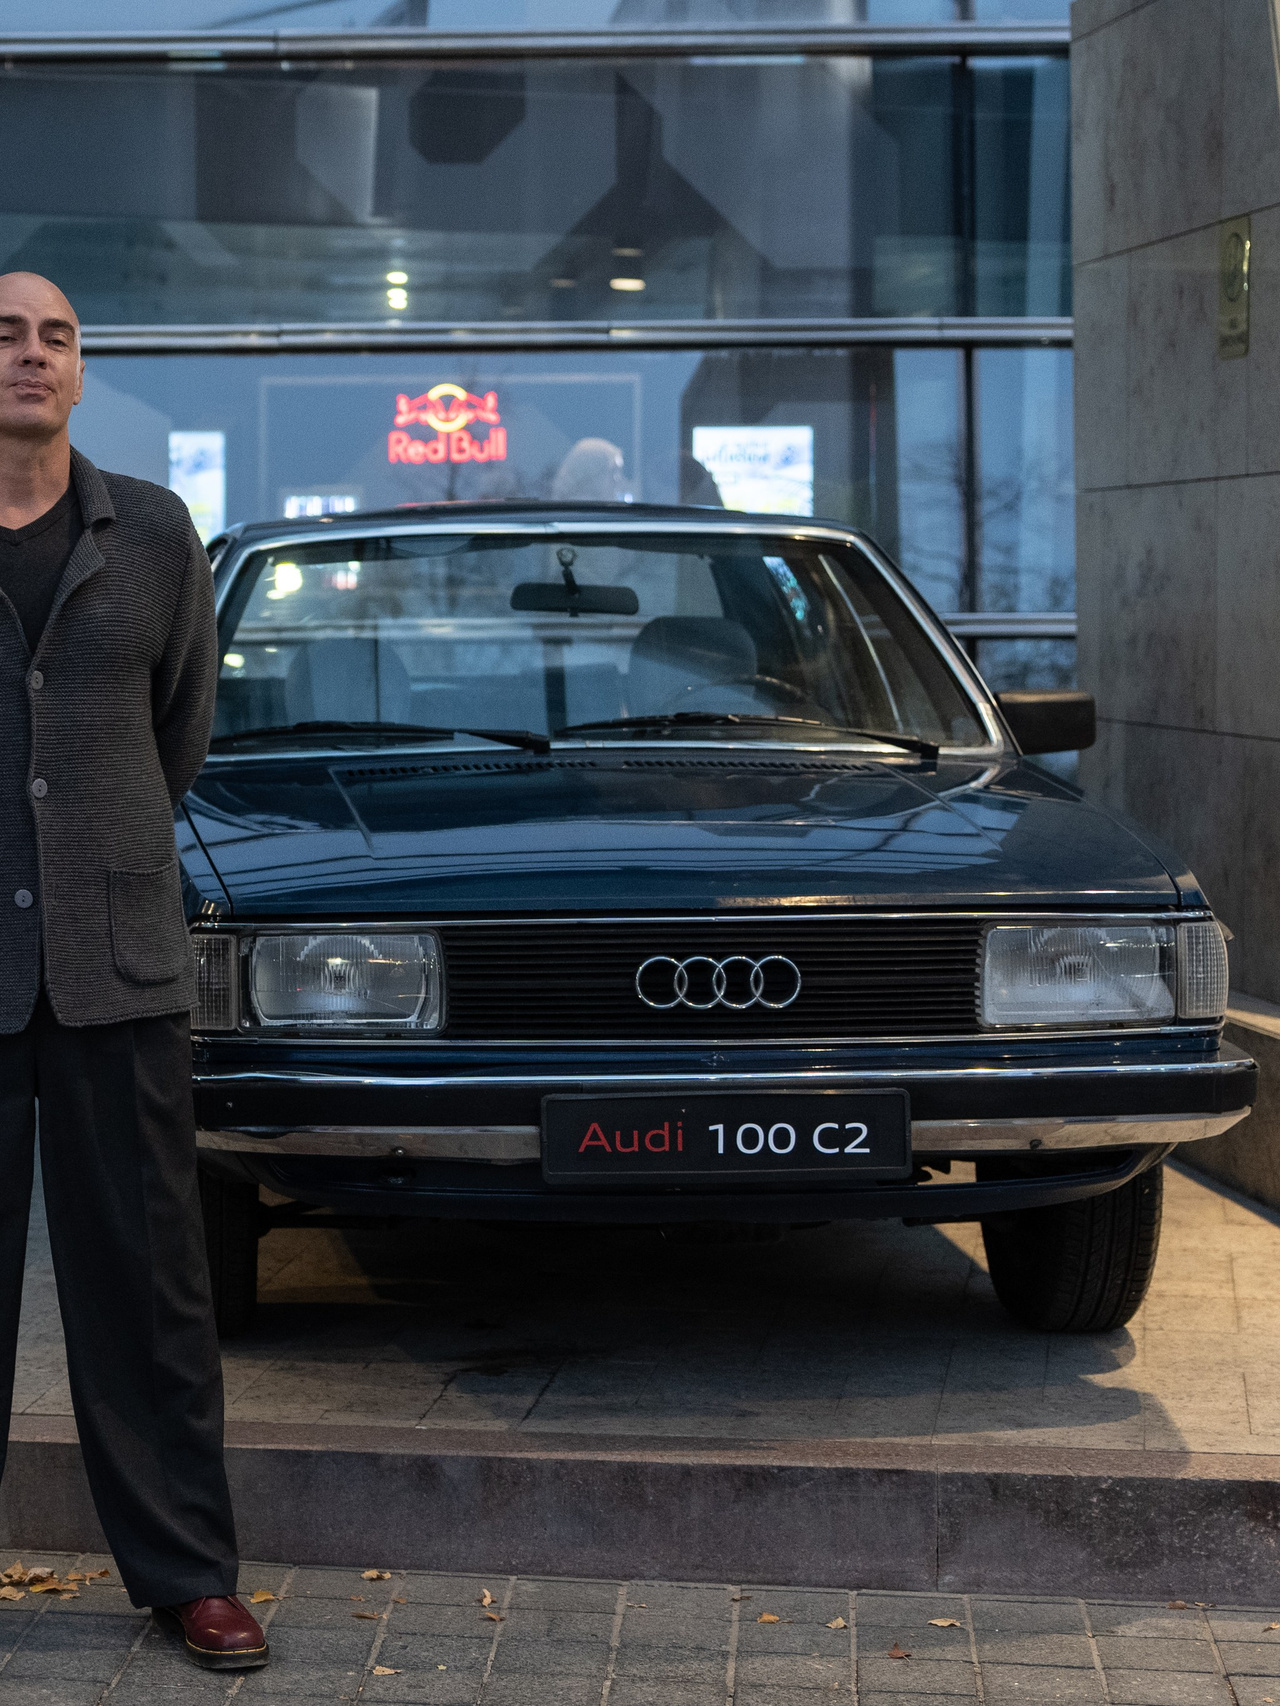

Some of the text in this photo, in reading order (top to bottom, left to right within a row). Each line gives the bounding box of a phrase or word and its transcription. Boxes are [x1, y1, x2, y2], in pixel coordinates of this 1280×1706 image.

[388, 427, 507, 464] Red Bull
[578, 1121, 871, 1155] Audi 100 C2
